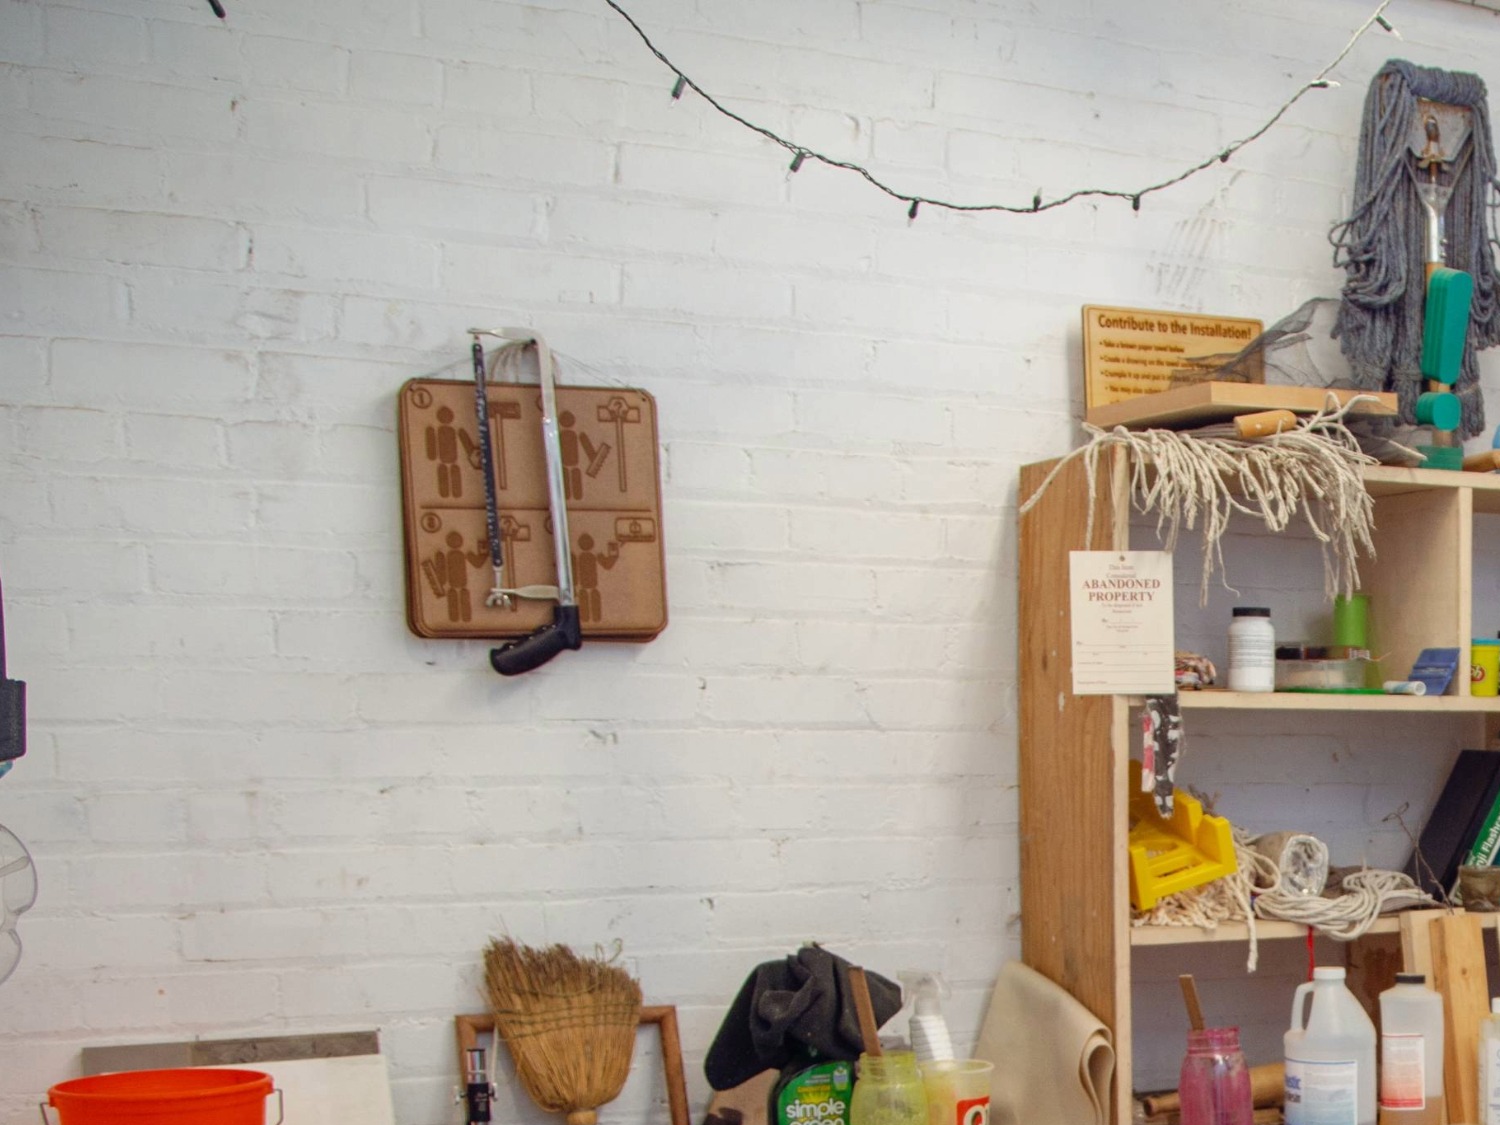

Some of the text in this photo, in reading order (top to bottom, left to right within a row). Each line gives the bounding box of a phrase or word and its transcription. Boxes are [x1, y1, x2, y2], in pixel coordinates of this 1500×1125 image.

[1098, 314, 1252, 340] Contribute to the Installation!
[1082, 579, 1161, 589] ABANDONED
[1088, 591, 1155, 602] PROPERTY
[786, 1097, 845, 1120] simple
